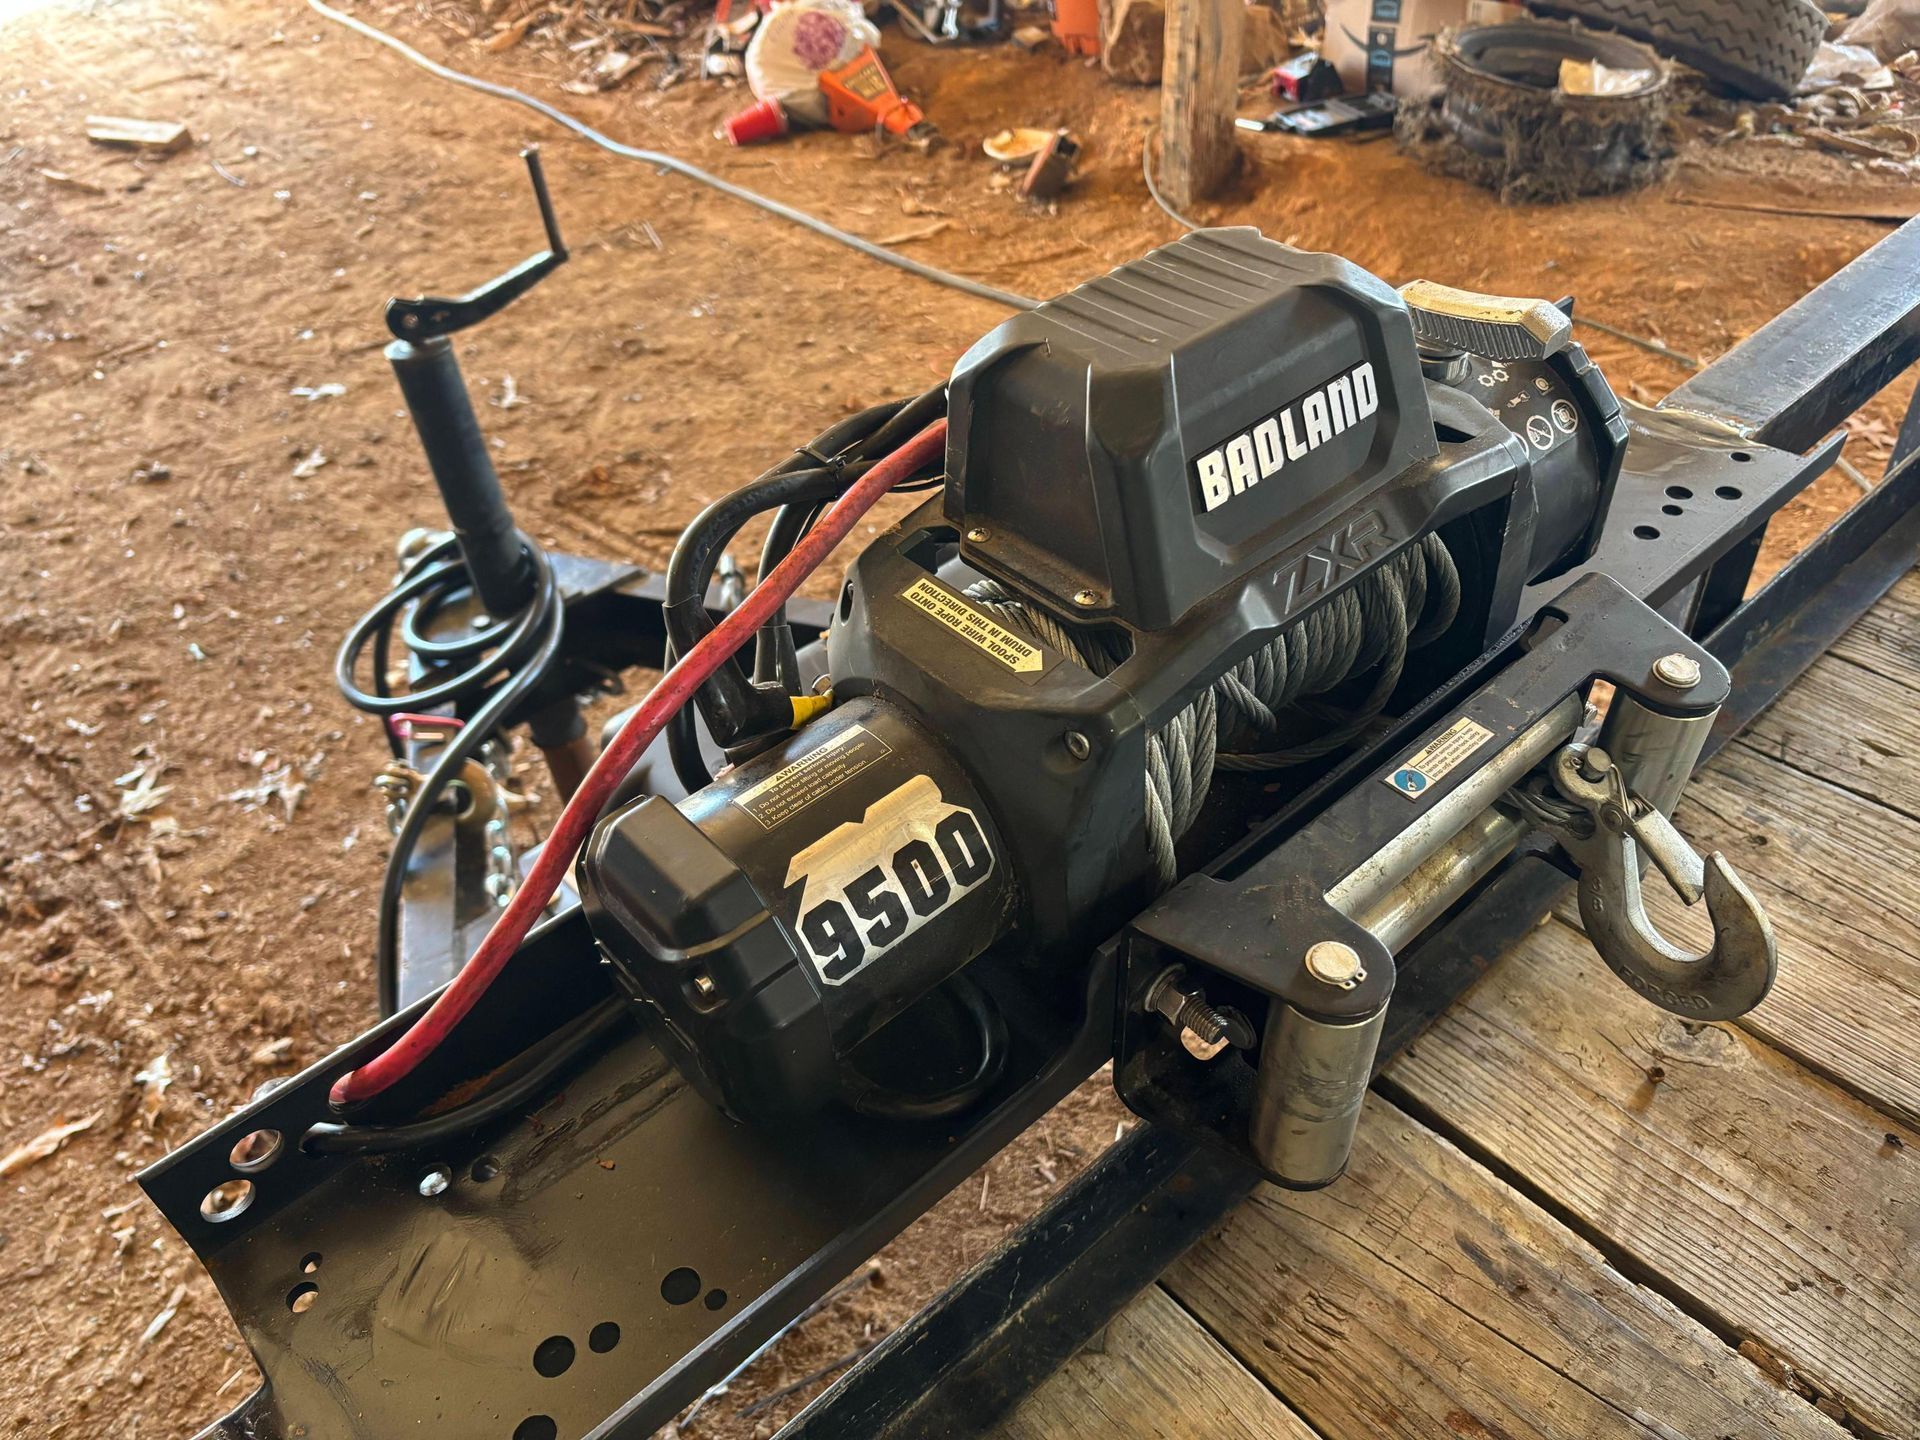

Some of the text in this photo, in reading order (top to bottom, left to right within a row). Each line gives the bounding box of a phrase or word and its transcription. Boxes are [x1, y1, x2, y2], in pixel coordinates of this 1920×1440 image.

[1196, 361, 1378, 512] BADLAND
[1273, 510, 1397, 615] ZXR
[909, 591, 1020, 664] SPOOL WIRE ROPE ONTO
[917, 582, 1032, 656] DRUM IN THIS DIRECTION
[780, 746, 828, 776] WARNING
[1423, 753, 1439, 765] prevent
[1427, 728, 1457, 750] WARNING
[758, 800, 770, 808] Do
[767, 793, 780, 802] not
[779, 786, 792, 795] use
[790, 780, 801, 788] for
[799, 770, 818, 783] lifting
[823, 753, 846, 769] moving
[765, 806, 776, 814] Do
[775, 799, 786, 808] not
[785, 785, 809, 801] exceed
[806, 776, 822, 787] load
[770, 807, 790, 821] Keep
[788, 798, 804, 809] clear
[810, 783, 828, 795] cable
[827, 772, 845, 785] under
[777, 771, 804, 788] prevent
[802, 757, 826, 772] serious
[801, 810, 991, 981] 9500
[1619, 965, 1712, 1009] FORGED
